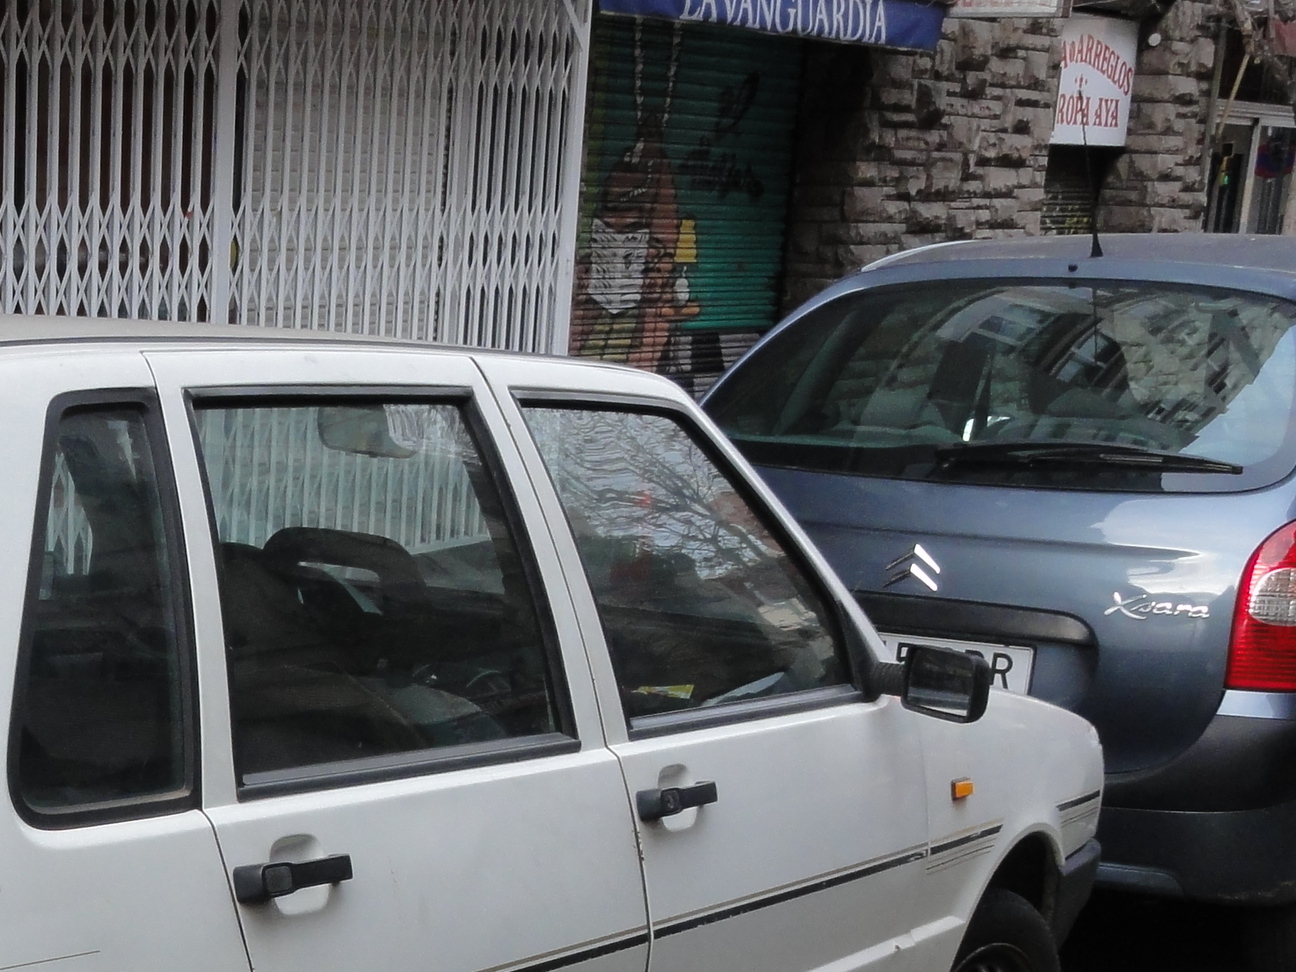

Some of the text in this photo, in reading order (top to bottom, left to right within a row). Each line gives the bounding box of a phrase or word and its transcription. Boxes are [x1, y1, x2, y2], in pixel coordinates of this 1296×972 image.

[723, 0, 888, 44] VANGUARDIA
[1057, 93, 1091, 126] ROPA
[1103, 592, 1210, 620] Xsara
